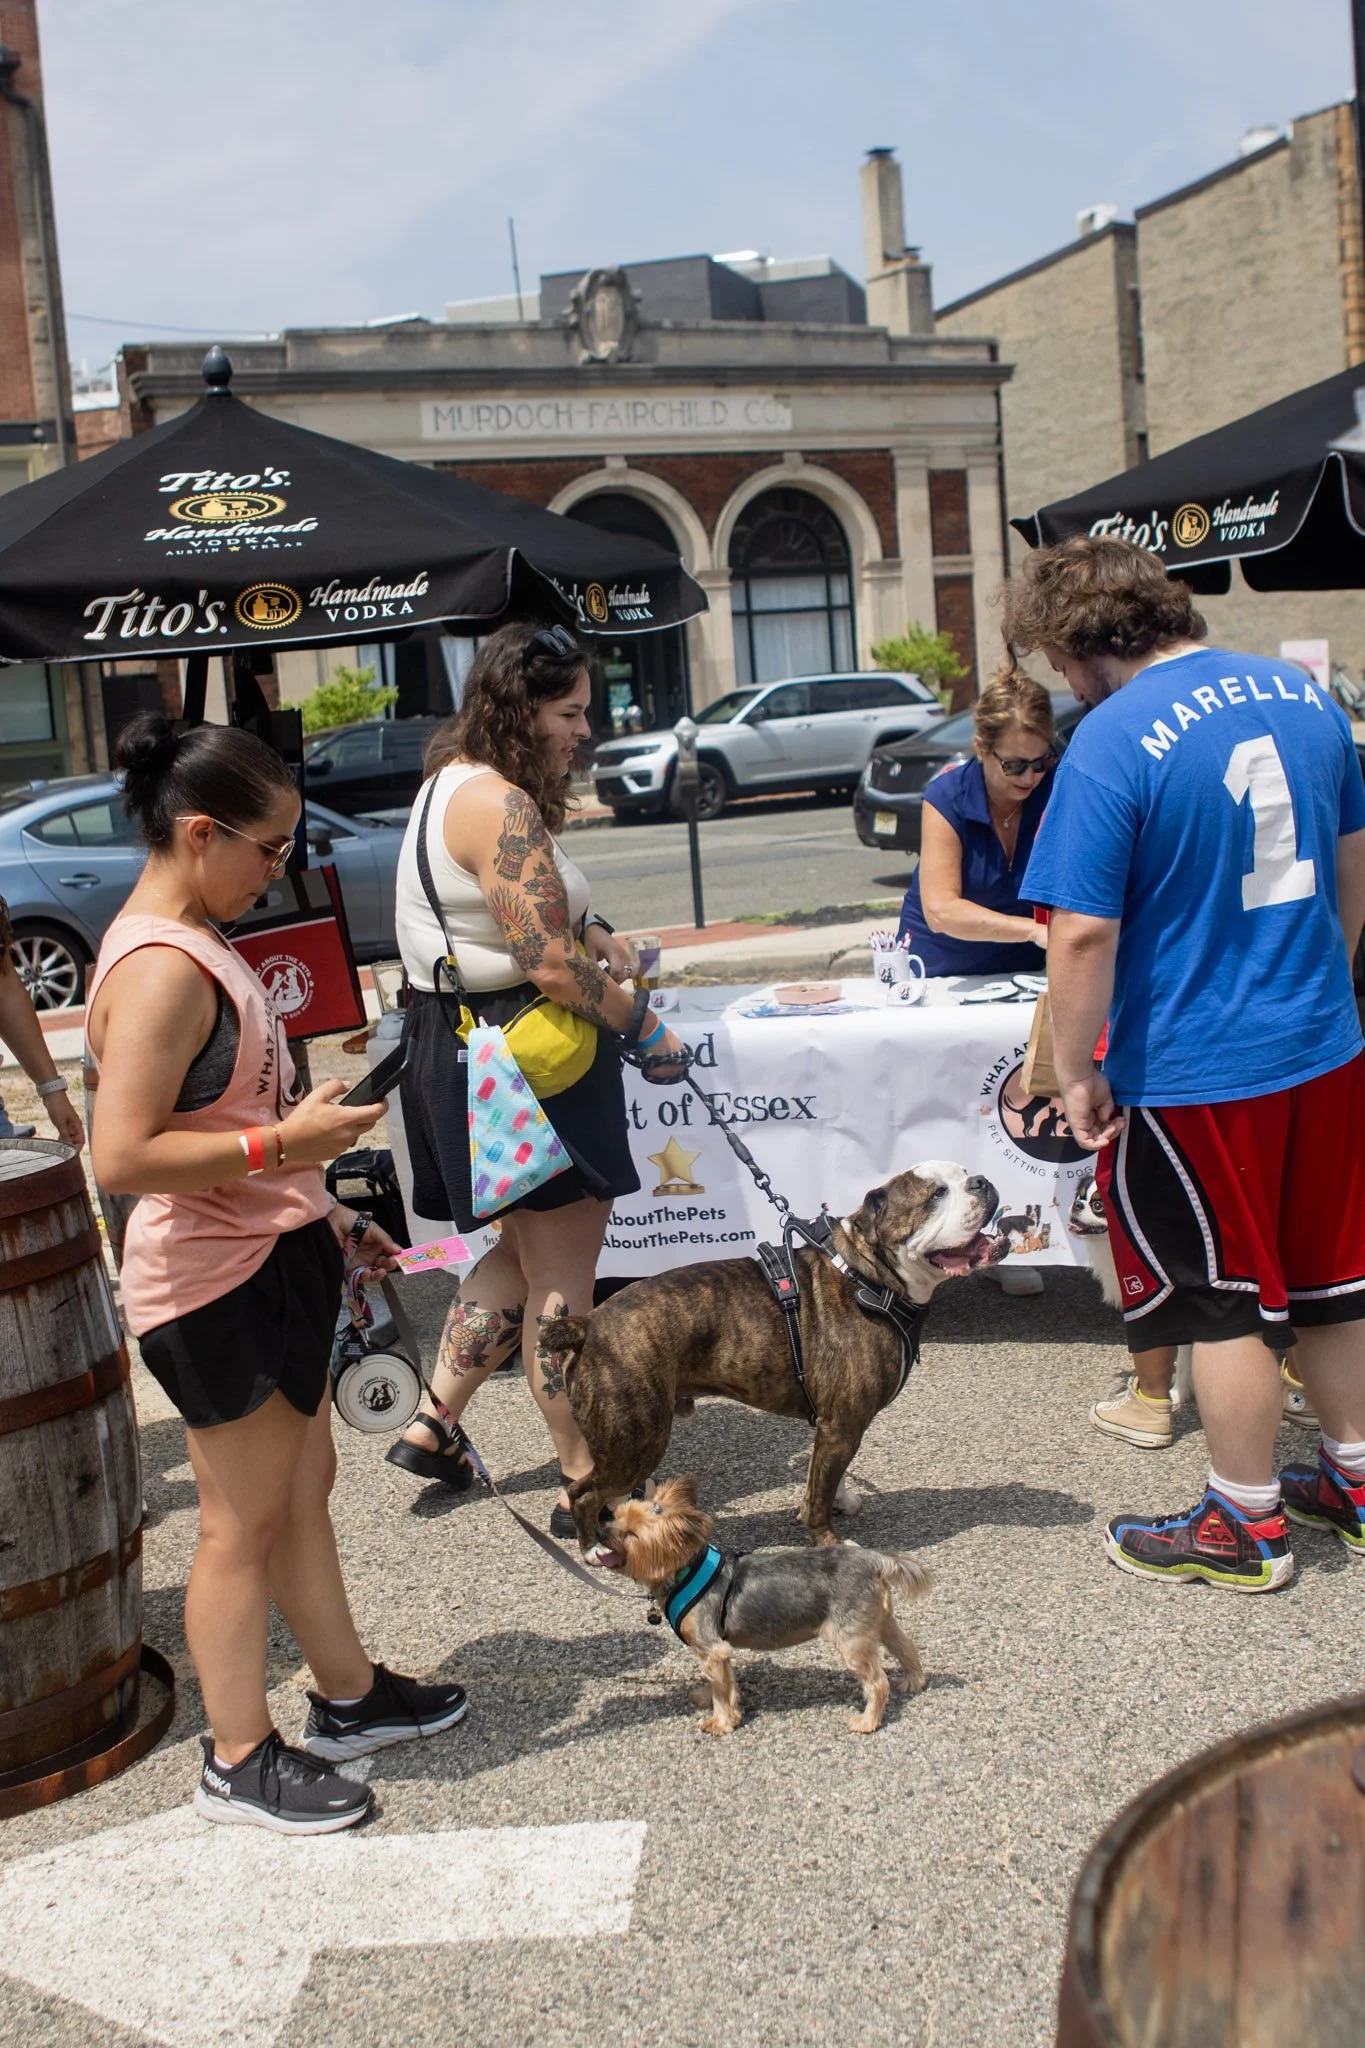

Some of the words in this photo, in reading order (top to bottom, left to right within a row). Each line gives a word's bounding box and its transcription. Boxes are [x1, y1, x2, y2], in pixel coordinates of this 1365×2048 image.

[433, 400, 729, 432] MURDOCH-FAIRCHILD
[1212, 490, 1279, 526] Handmade
[144, 517, 319, 541] Handmade
[189, 536, 278, 548] VODKA
[1220, 521, 1266, 542] VODKA
[165, 547, 220, 556] AUSTIN
[250, 541, 303, 550] TEXAS
[309, 571, 429, 608] Handmade
[608, 583, 650, 606] Handmade
[326, 601, 415, 623] VODKA
[615, 607, 654, 620] VODKA
[1140, 675, 1324, 760] MARELLA
[1223, 734, 1316, 911] 1
[256, 1033, 275, 1097] WHAT
[980, 1056, 1009, 1095] WHAT
[658, 1093, 693, 1126] of
[705, 1091, 817, 1126] Essex
[988, 1124, 1003, 1145] PET
[1003, 1148, 1046, 1177] SITTING
[1066, 1165, 1093, 1179] DOG
[1201, 1531, 1231, 1541] FILA
[203, 1764, 231, 1796] HOKA
